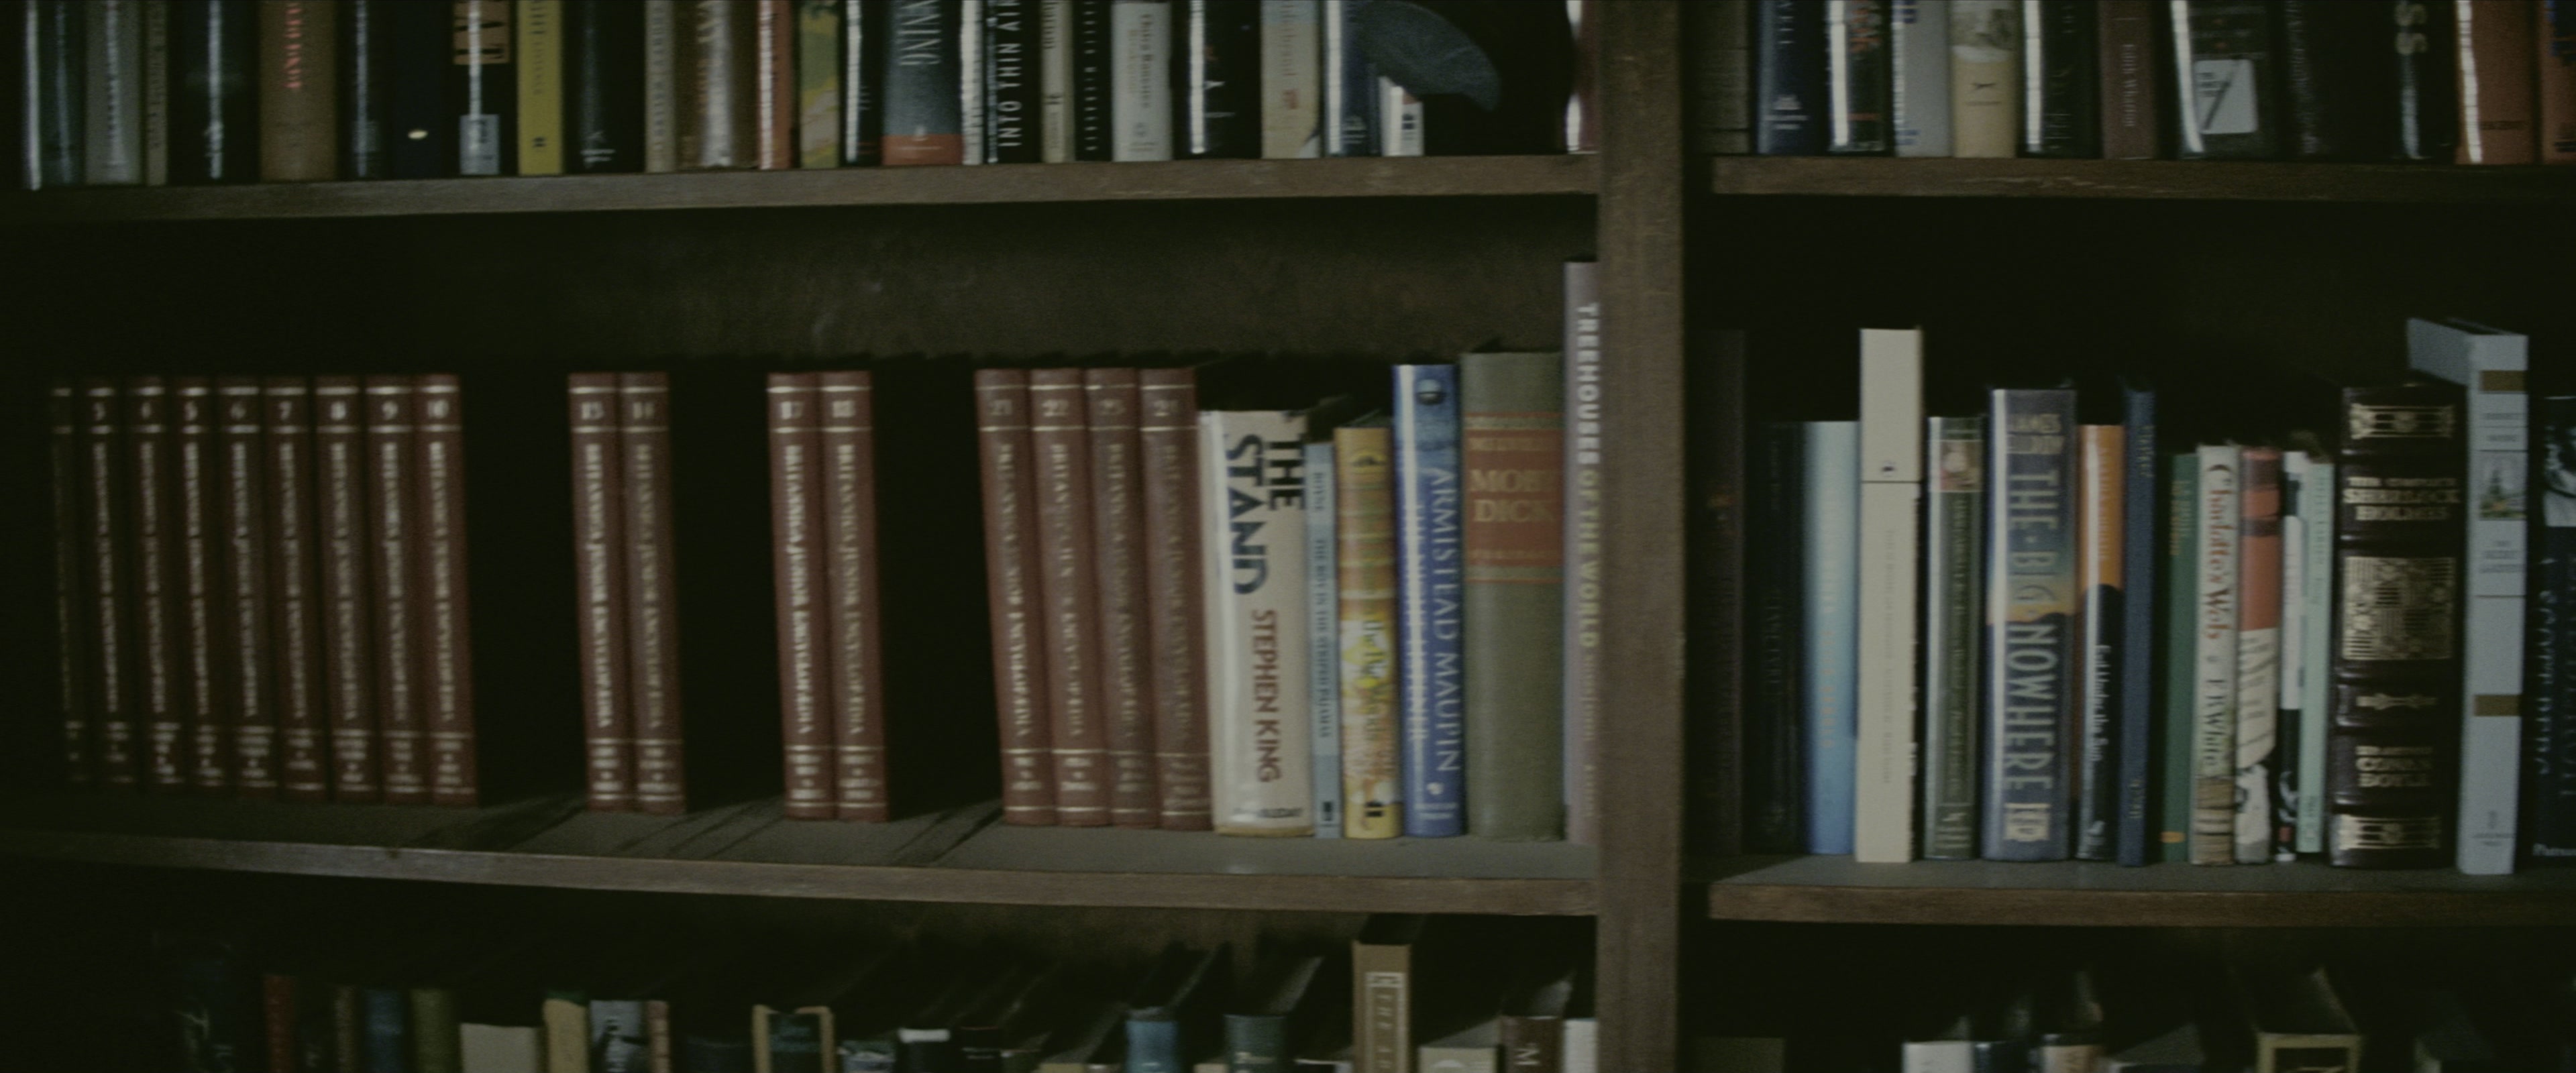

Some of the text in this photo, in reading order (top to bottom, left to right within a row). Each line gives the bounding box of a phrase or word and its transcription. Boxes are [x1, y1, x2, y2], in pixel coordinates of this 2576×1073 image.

[997, 43, 1023, 89] THIN
[997, 100, 1024, 147] INTO
[1577, 302, 1600, 465] TREEHOUSES
[1269, 440, 1305, 510] THE
[1577, 471, 1600, 502] OF
[2010, 470, 2059, 530] THE
[1226, 435, 1269, 594] STAND
[1474, 499, 1554, 522] DICK
[1578, 506, 1601, 555] THE
[1429, 468, 1460, 771] ARMISTEAD MAUPIN
[1578, 561, 1601, 647] WORLD
[1251, 609, 1282, 783] STEPHEN KING
[2004, 624, 2058, 791] NOWHERE
